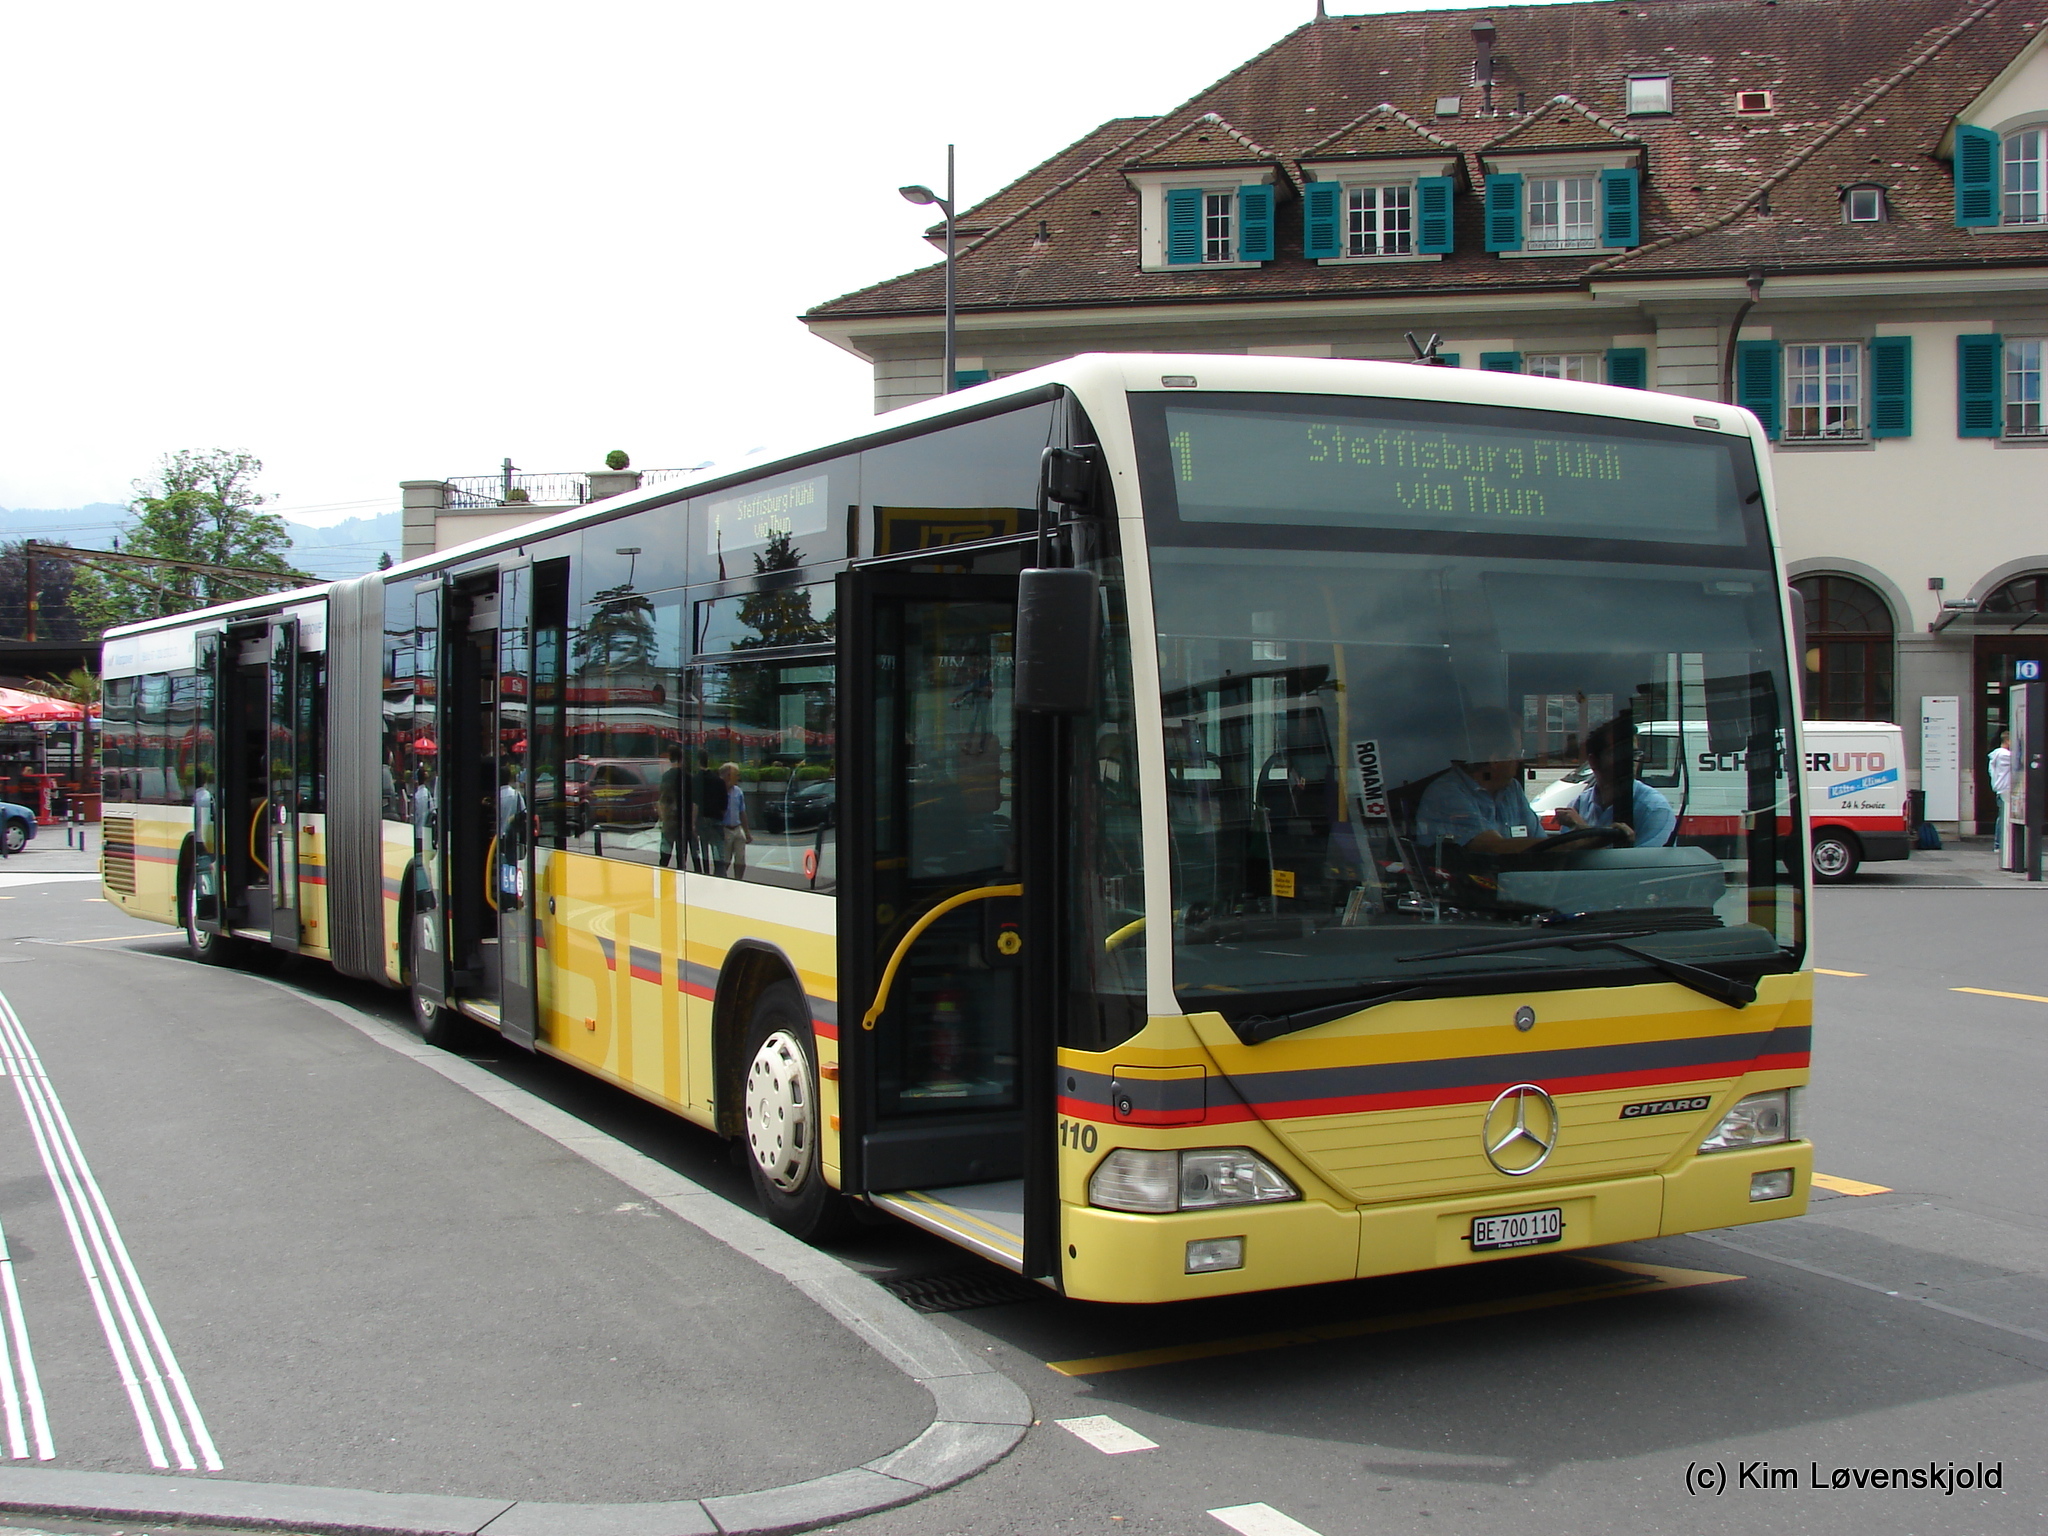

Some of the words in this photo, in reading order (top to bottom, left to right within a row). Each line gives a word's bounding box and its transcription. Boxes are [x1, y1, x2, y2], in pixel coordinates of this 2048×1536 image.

[1170, 431, 1192, 481] 1
[1308, 424, 1524, 479] Steffisburg
[1534, 439, 1621, 481] Flühli
[1397, 473, 1452, 509] via
[1464, 475, 1545, 516] Thun
[1841, 800, 1852, 809] 24
[1854, 800, 1859, 809] h
[1861, 800, 1885, 809] Service
[1624, 1098, 1707, 1116] CITARO
[1060, 1119, 1098, 1153] 110
